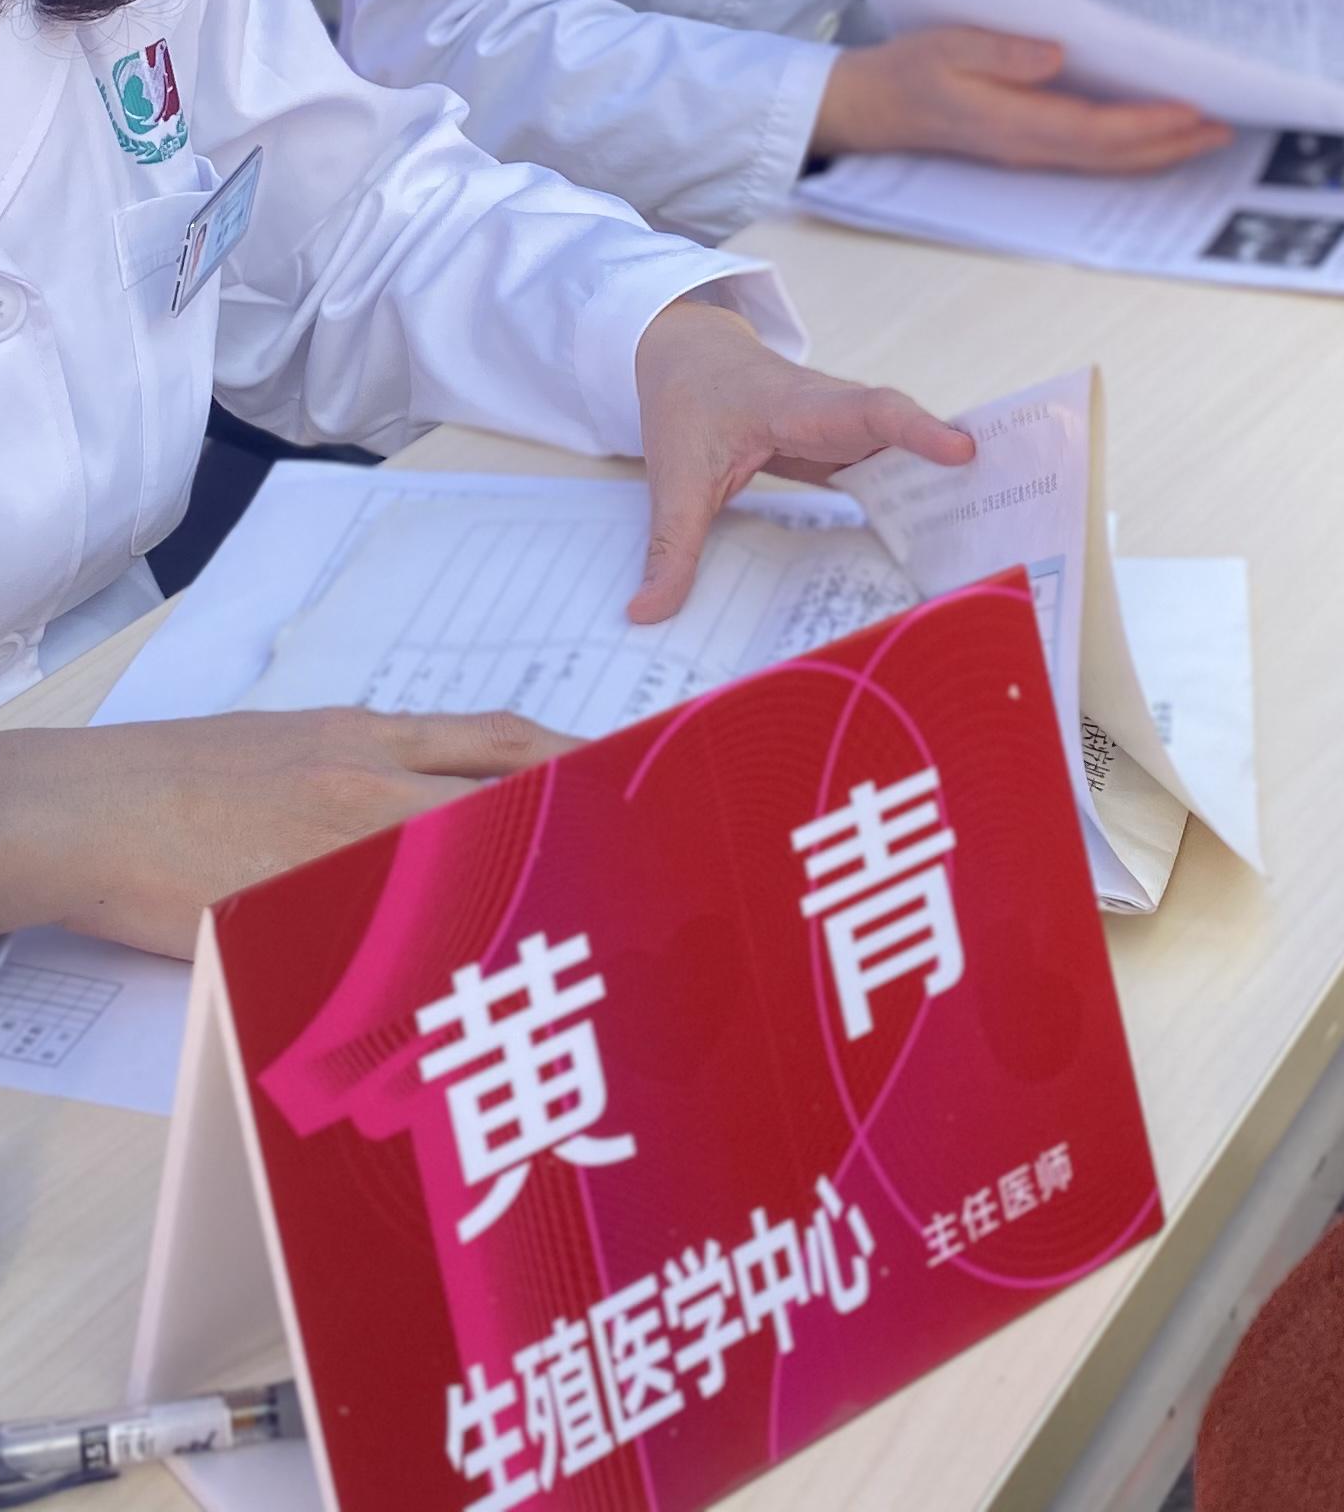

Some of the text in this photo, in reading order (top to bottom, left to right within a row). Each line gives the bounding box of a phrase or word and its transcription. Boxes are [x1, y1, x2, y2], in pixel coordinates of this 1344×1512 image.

[415, 765, 964, 1244] 黄 青
[445, 1172, 876, 1512] 生殖医学中心
[920, 1141, 1074, 1269] 主任医师
